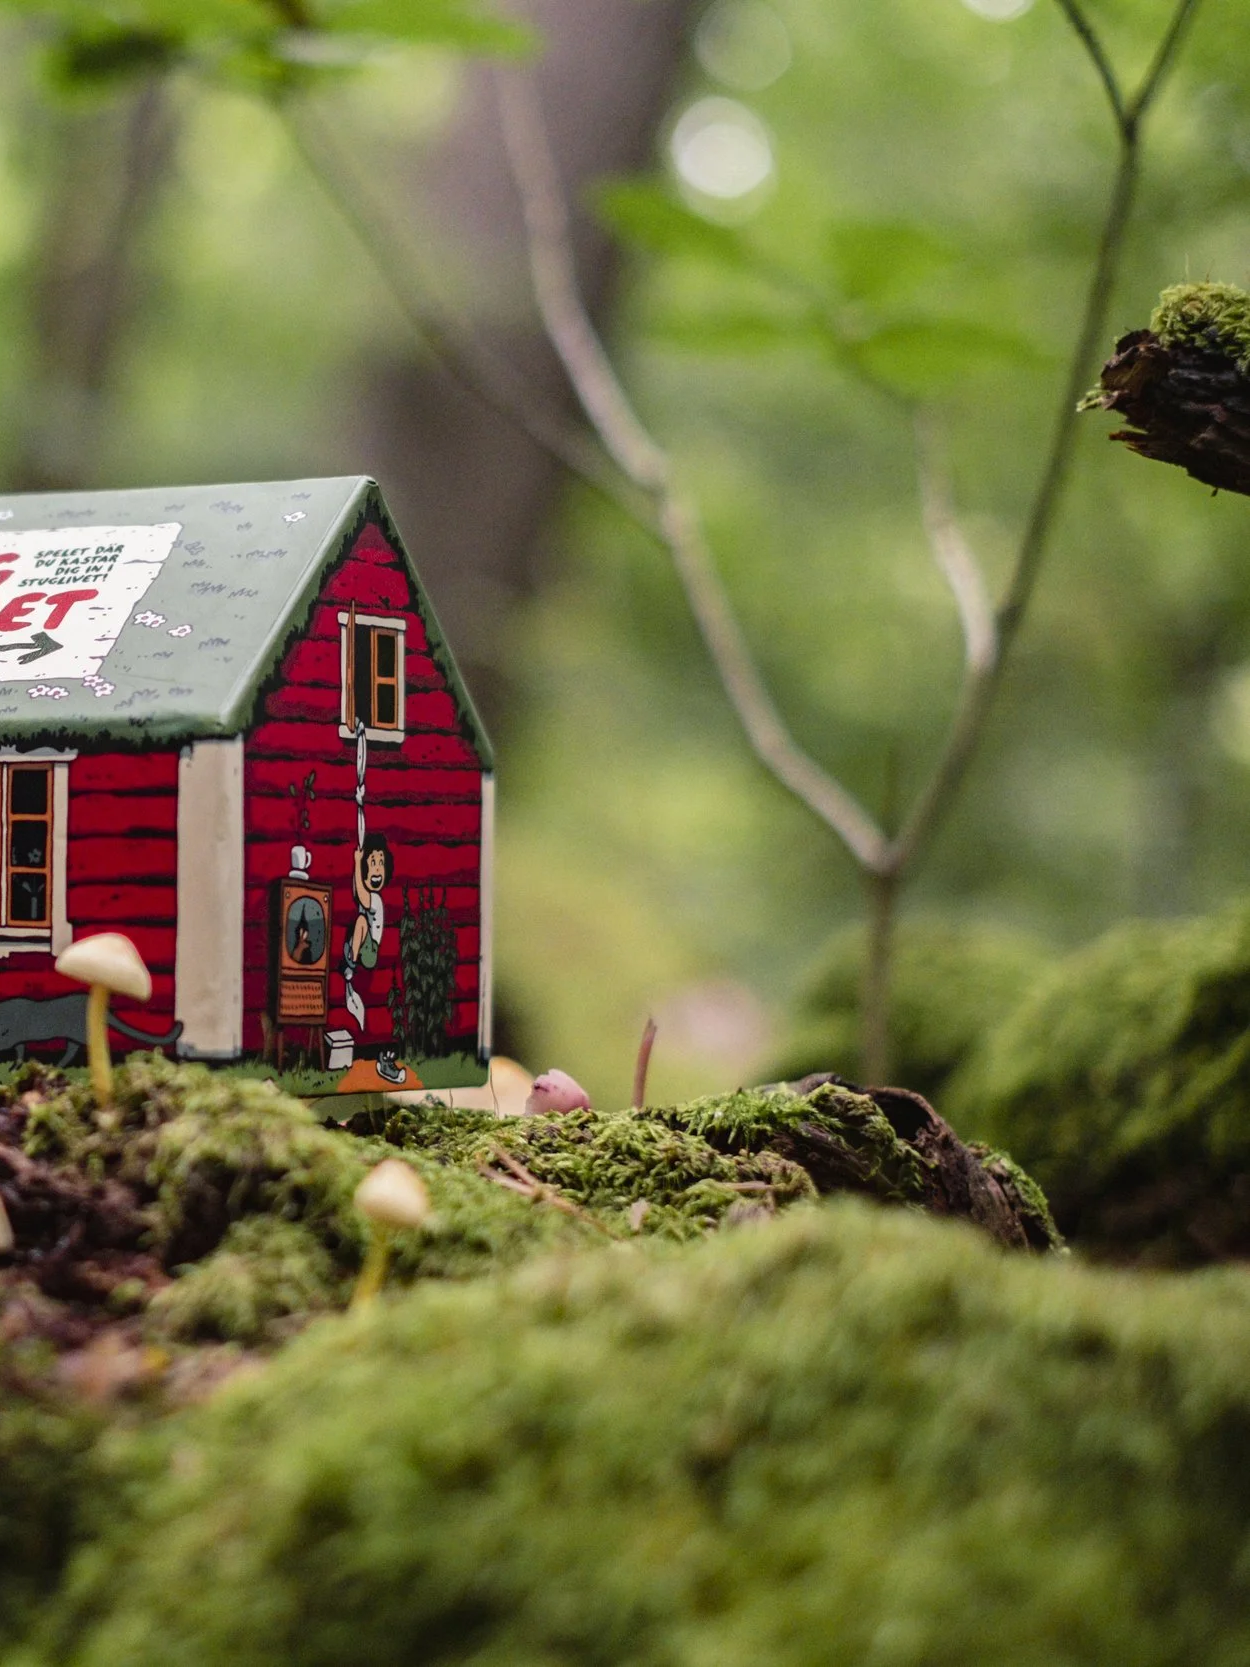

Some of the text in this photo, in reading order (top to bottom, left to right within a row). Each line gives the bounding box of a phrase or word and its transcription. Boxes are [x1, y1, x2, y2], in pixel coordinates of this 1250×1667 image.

[34, 543, 125, 559] SPELET DÄR
[35, 554, 119, 568] DU KASTAR
[55, 564, 114, 576] DIG IN I
[18, 573, 108, 587] STUGLIVET!
